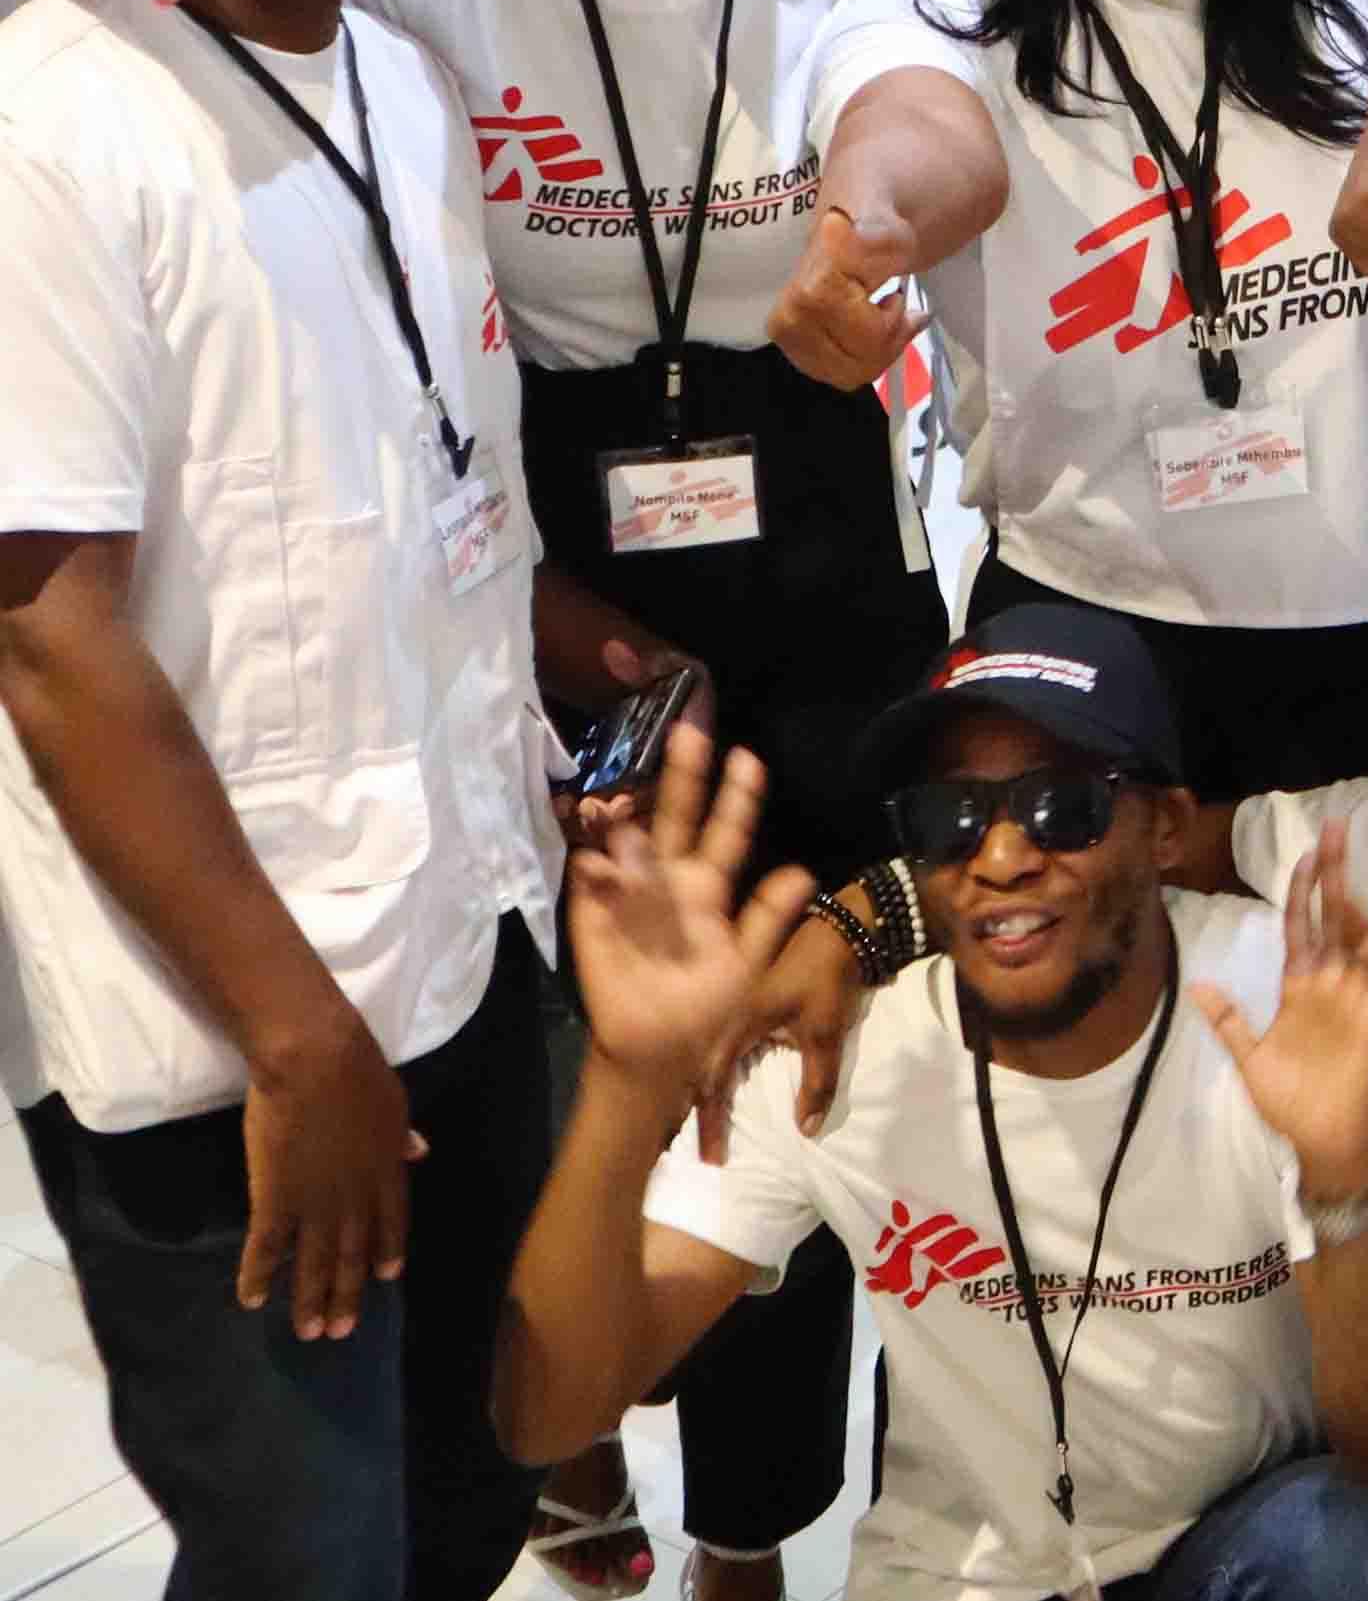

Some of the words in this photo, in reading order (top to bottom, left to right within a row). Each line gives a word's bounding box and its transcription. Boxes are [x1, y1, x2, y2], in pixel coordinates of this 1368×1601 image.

[535, 183, 669, 209] MEDECS
[679, 179, 743, 208] SNS
[525, 212, 655, 238] DOCTOR
[664, 204, 784, 236] WTHOUT
[1222, 250, 1368, 306] MEDECIN
[670, 509, 700, 522] MSF
[959, 1273, 1068, 1305] MEDEINS
[1145, 1241, 1289, 1286] FRONTIERES
[1187, 1262, 1292, 1309] BORDERS
